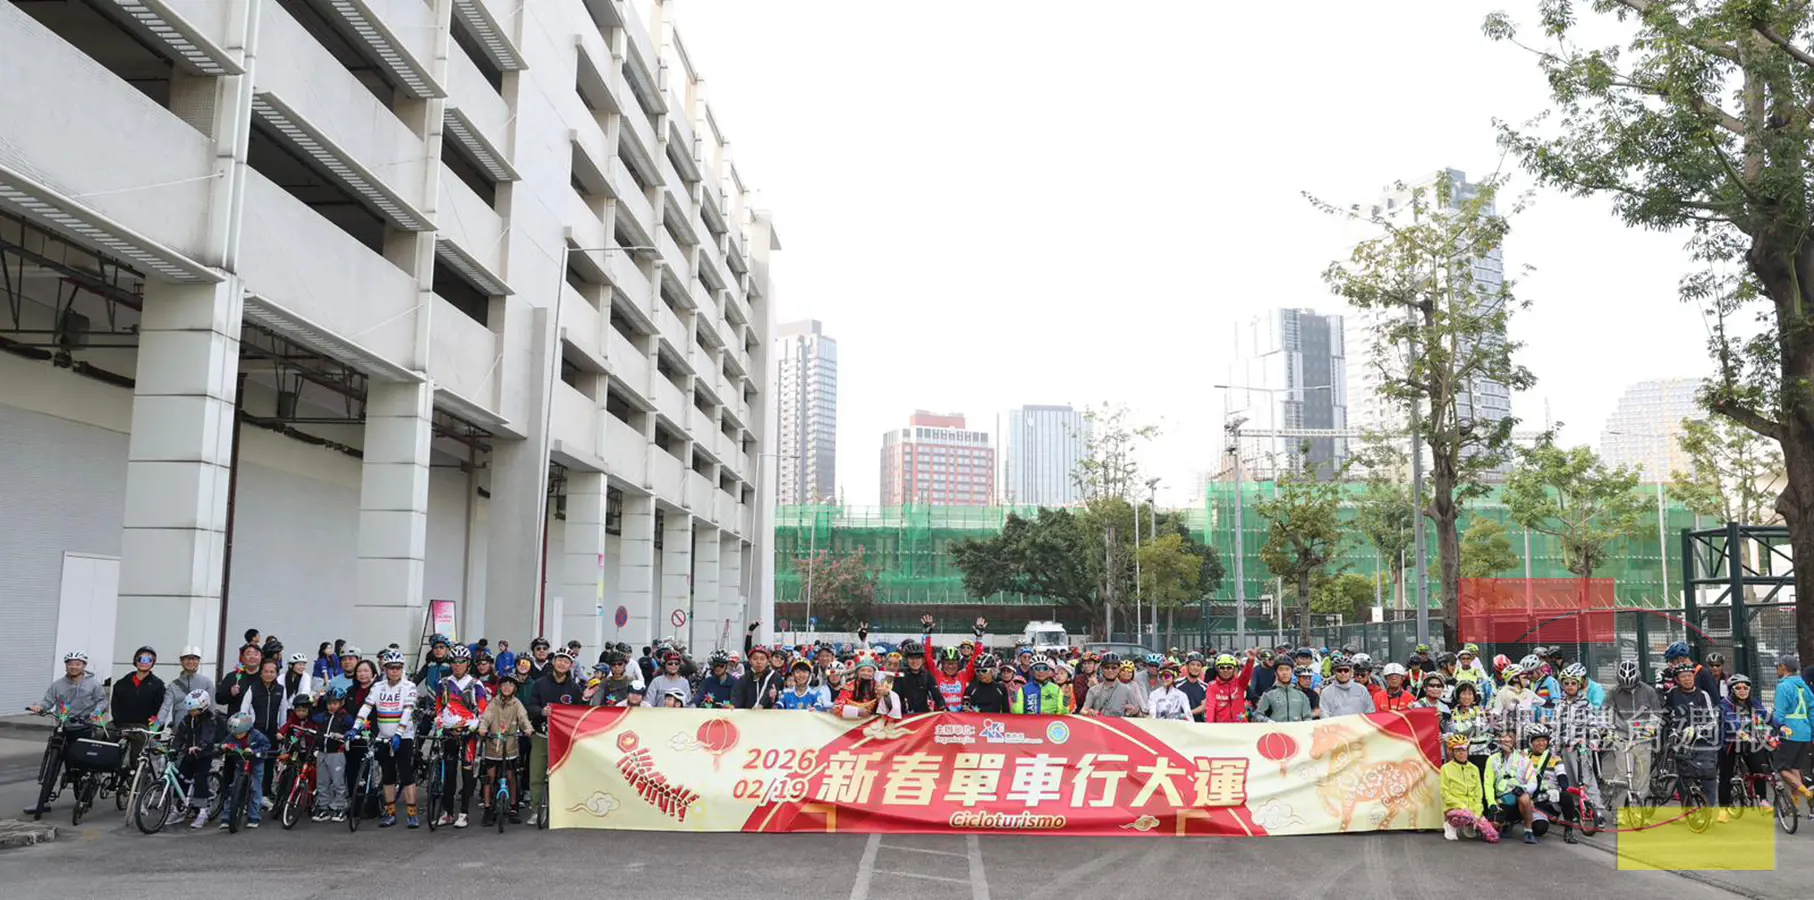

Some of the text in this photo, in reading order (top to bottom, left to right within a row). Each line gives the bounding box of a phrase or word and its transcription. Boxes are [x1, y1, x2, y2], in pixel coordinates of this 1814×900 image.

[380, 691, 401, 701] UAE
[742, 747, 816, 771] 2026
[732, 777, 806, 804] 02/19
[816, 752, 1248, 808] 新春單車行大運
[950, 811, 1066, 828] Cicloturismo
